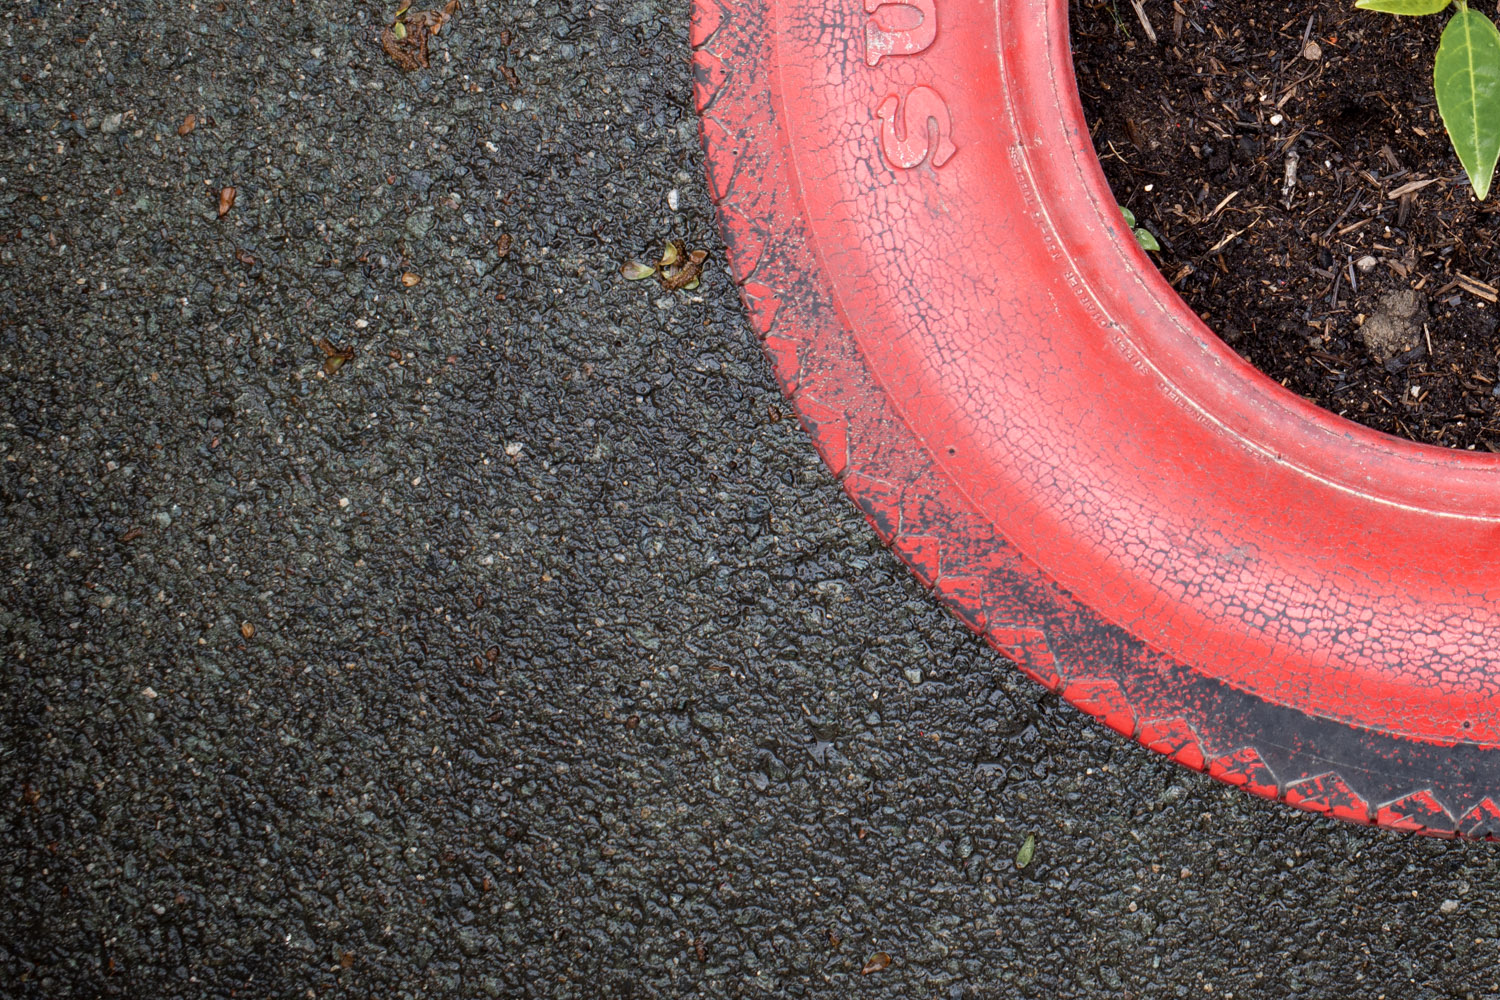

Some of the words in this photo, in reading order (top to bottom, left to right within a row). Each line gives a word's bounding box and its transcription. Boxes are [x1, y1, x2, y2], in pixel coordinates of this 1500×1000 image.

[1007, 144, 1034, 206] TUBELESS
[1065, 270, 1106, 329] CHARGER
[1111, 335, 1148, 376] SUPER
